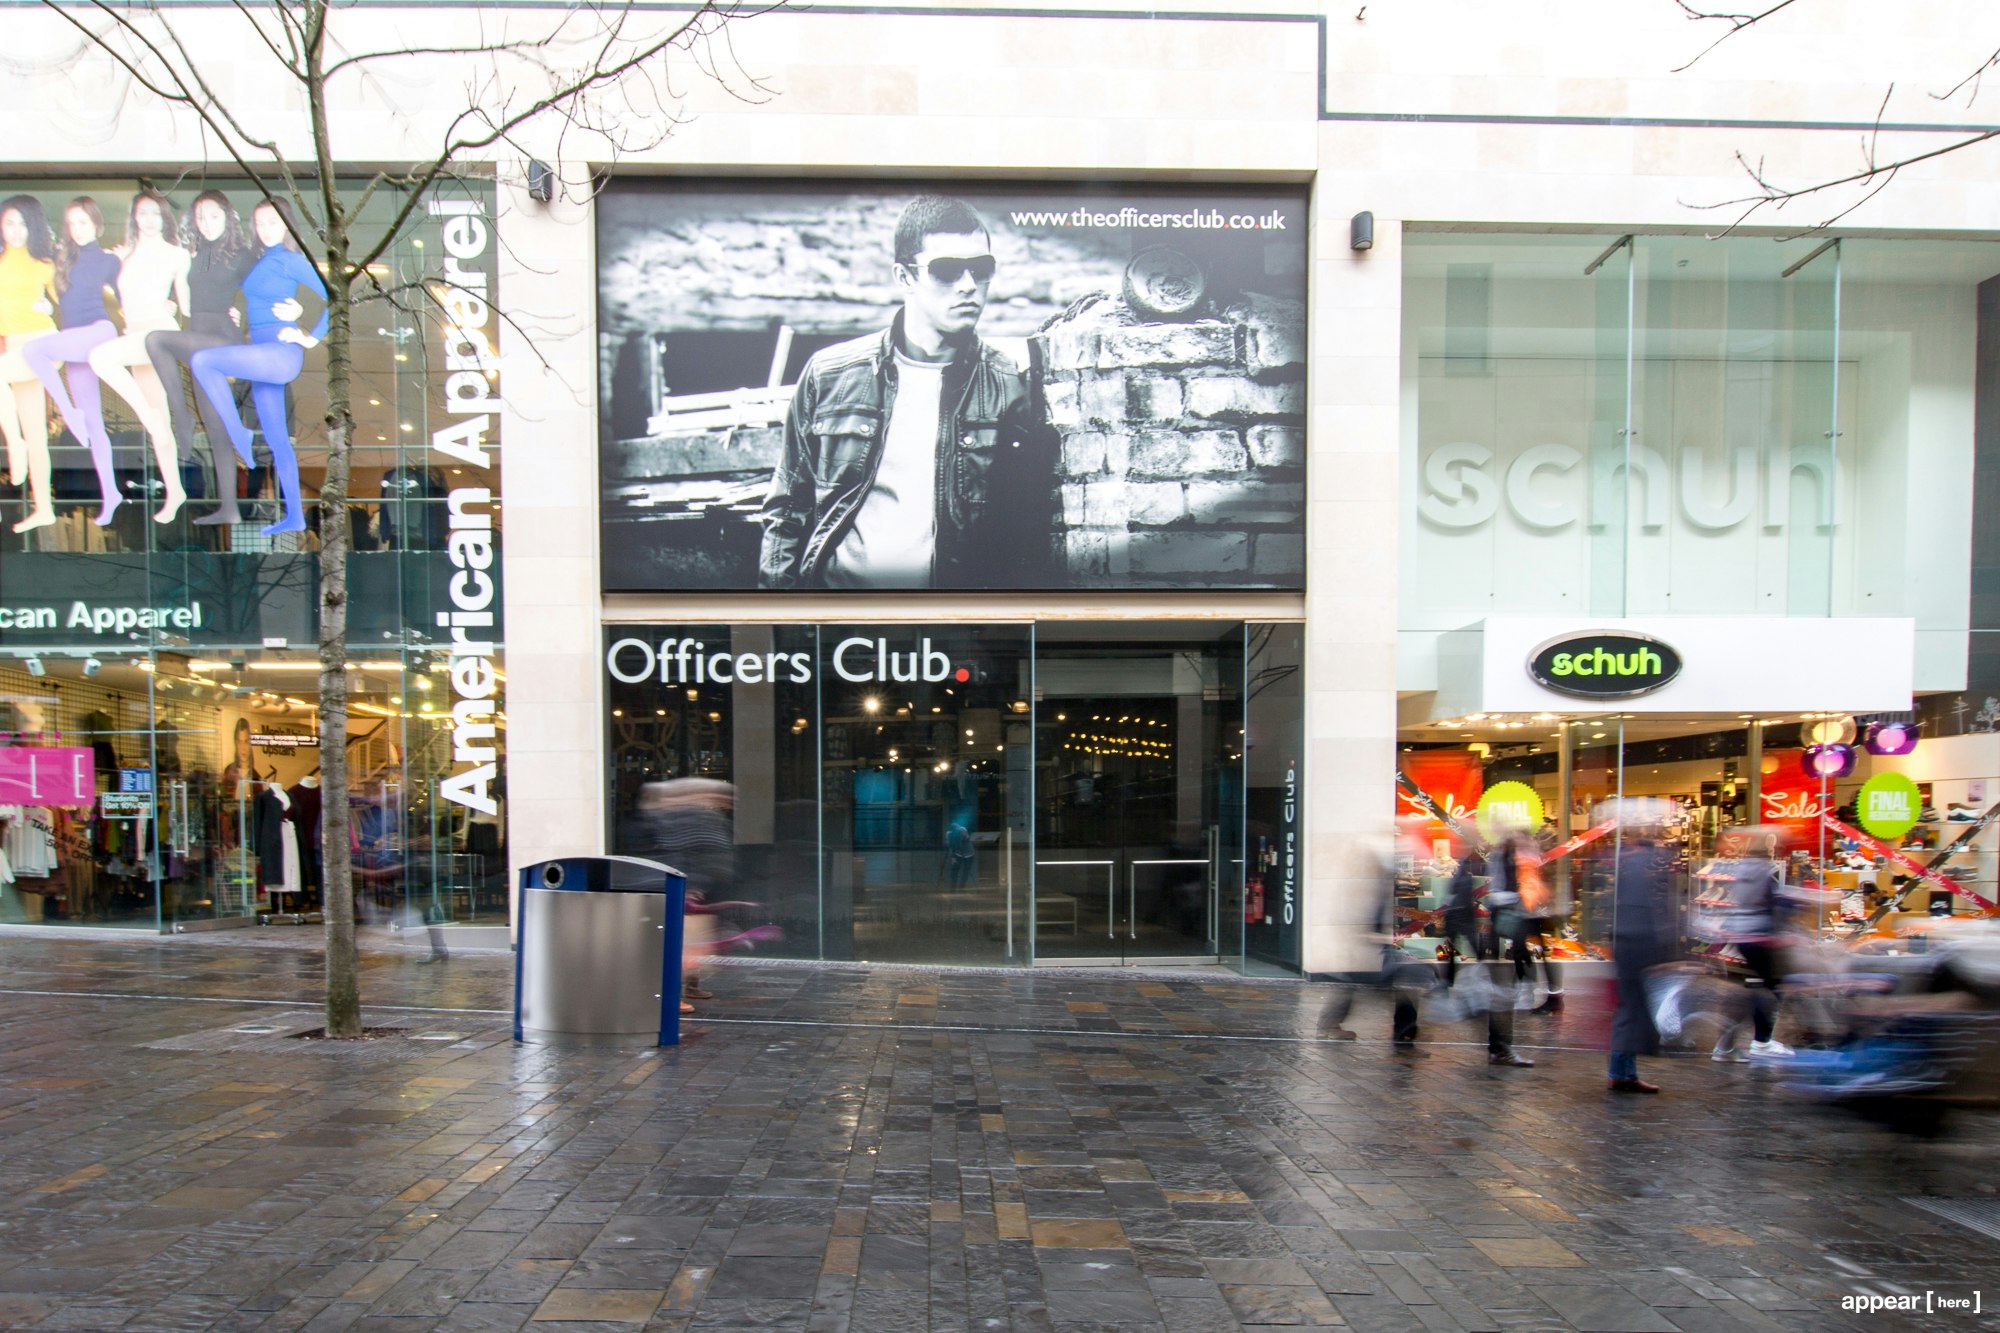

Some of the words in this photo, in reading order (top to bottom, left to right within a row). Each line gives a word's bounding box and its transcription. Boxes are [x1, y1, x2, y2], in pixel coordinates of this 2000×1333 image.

[1010, 207, 1286, 230] www.theofficersclub.co.uk
[429, 200, 501, 470] Apparel
[67, 601, 201, 634] Apparel
[437, 487, 497, 816] American
[606, 637, 812, 684] Officers
[1551, 646, 1662, 676] schuh
[1760, 791, 1834, 819] Sale
[1869, 791, 1911, 811] FINAL
[1284, 832, 1294, 925] Officers
